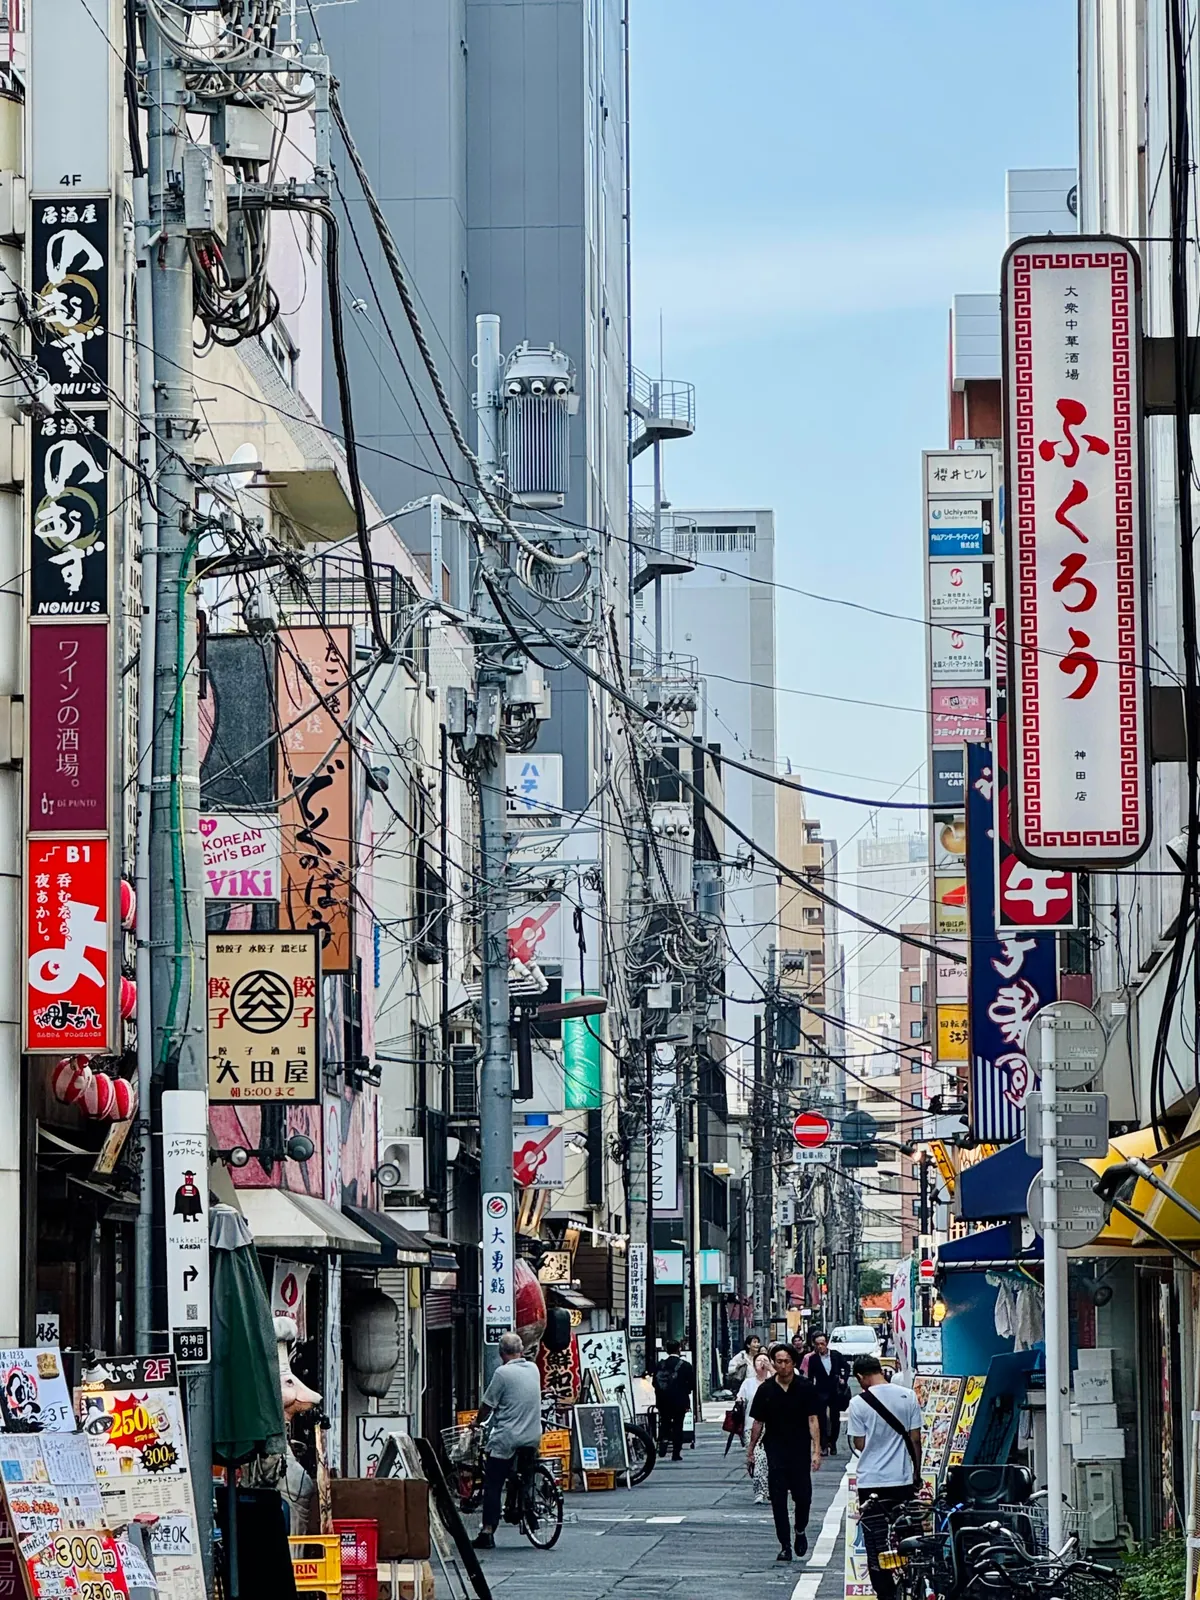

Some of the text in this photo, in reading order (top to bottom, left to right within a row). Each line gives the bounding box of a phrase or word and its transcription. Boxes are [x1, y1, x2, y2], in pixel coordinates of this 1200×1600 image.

[60, 175, 82, 187] 4F
[41, 204, 98, 225] 居酒屋
[1064, 285, 1080, 381] 大衆中華酒場
[50, 382, 102, 396] OMU'S
[41, 415, 96, 436] 居酒屋
[943, 508, 978, 516] Uchiyama
[983, 519, 990, 535] 6
[1038, 398, 1111, 700] ふくろう
[984, 582, 991, 597] 5
[37, 601, 101, 615] NOMU'S
[55, 640, 80, 788] ワインの酒場。
[1074, 750, 1088, 802] 神田店
[201, 823, 212, 832] B1
[202, 829, 272, 852] KOREAN
[66, 846, 91, 863] B1
[250, 843, 277, 858] Bar
[205, 870, 273, 897] ViKi
[34, 873, 51, 942] 夜あかし。
[939, 920, 965, 928] 神田江戸
[208, 976, 231, 1029] 餃子
[293, 975, 316, 1029] 餃子
[218, 1046, 306, 1056] 餃子酒場
[216, 1060, 309, 1084] 大田屋
[230, 1087, 296, 1098] 朝 5:00 まで
[167, 1148, 205, 1157] クラフトビール
[171, 1140, 202, 1148] バーガーと
[490, 1226, 506, 1295] 大勇鮨
[497, 1305, 511, 1313] 入口
[36, 1322, 60, 1343] 豚
[180, 1334, 205, 1346] 内神田
[181, 1347, 204, 1358] 3-18
[144, 1358, 172, 1382] 2F
[590, 1407, 609, 1466] 営業中
[54, 1536, 117, 1569] 300円
[295, 1563, 318, 1575] RIN
